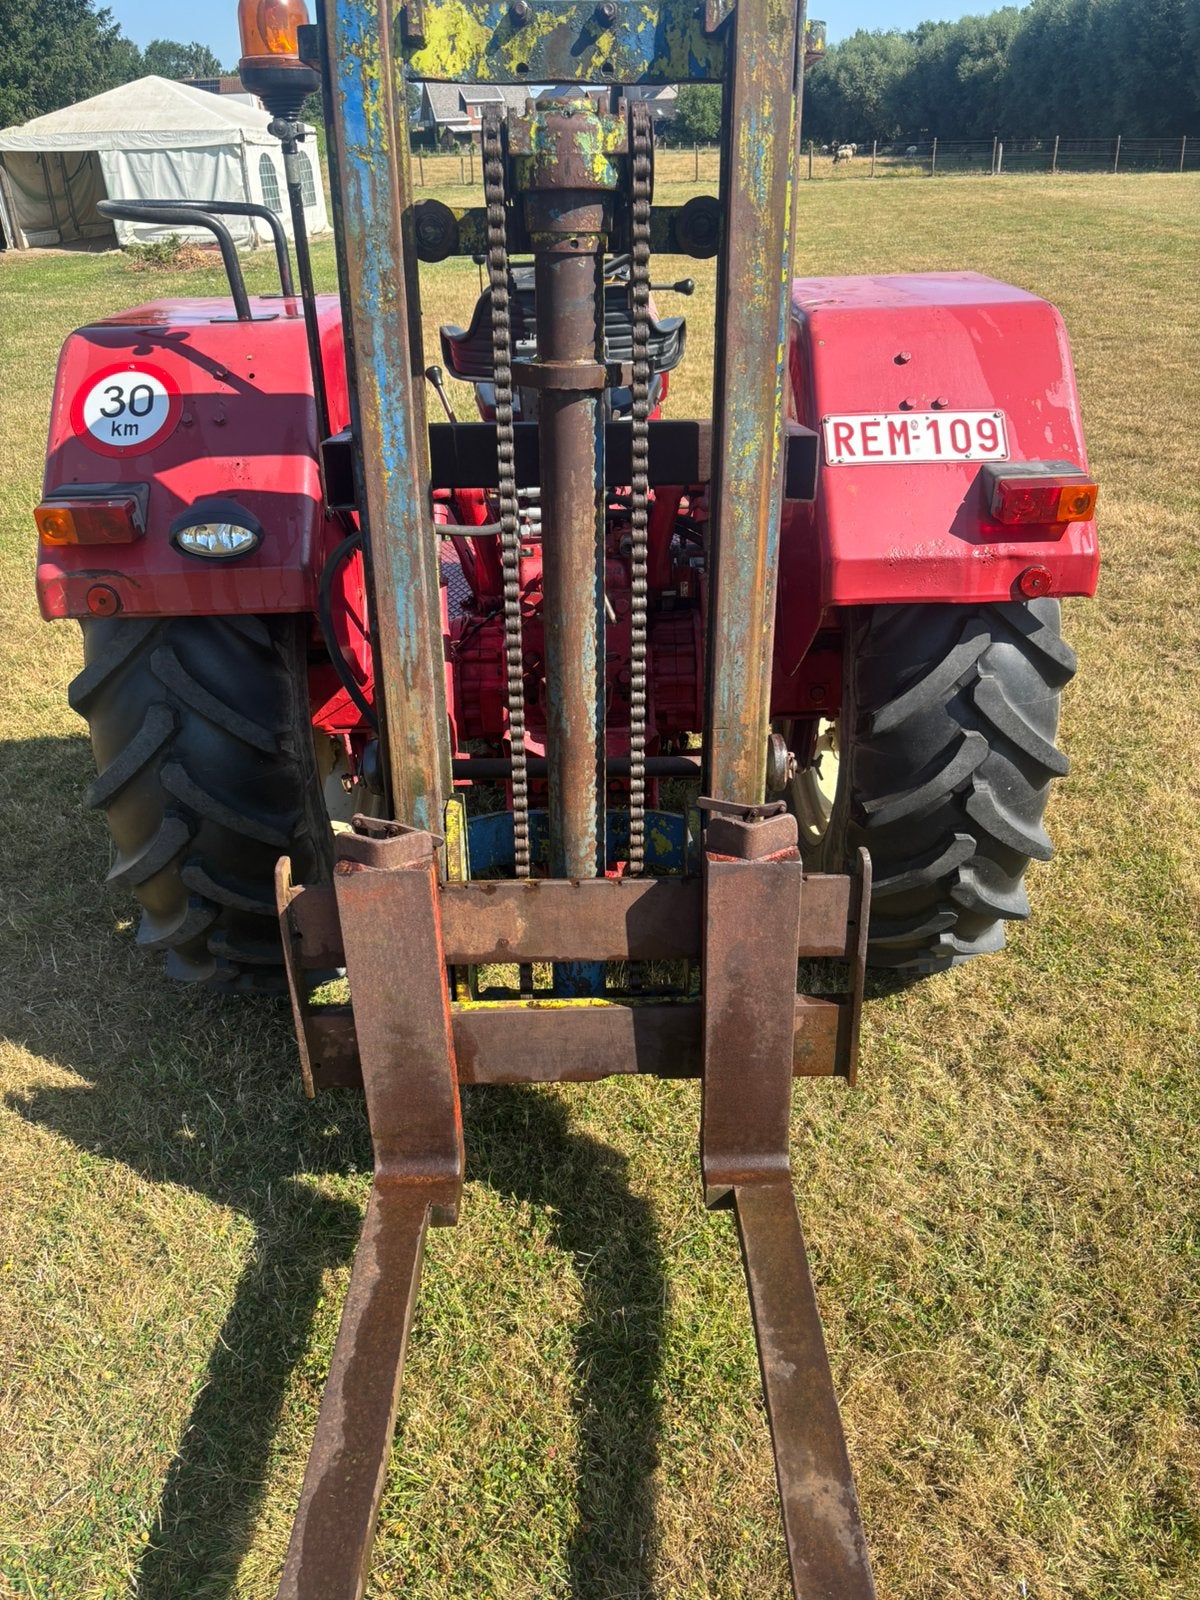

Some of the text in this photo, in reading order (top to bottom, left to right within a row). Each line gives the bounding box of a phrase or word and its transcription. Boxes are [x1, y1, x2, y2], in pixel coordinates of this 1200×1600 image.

[100, 384, 154, 418] 30
[111, 421, 139, 437] km
[833, 418, 999, 457] REM-109
